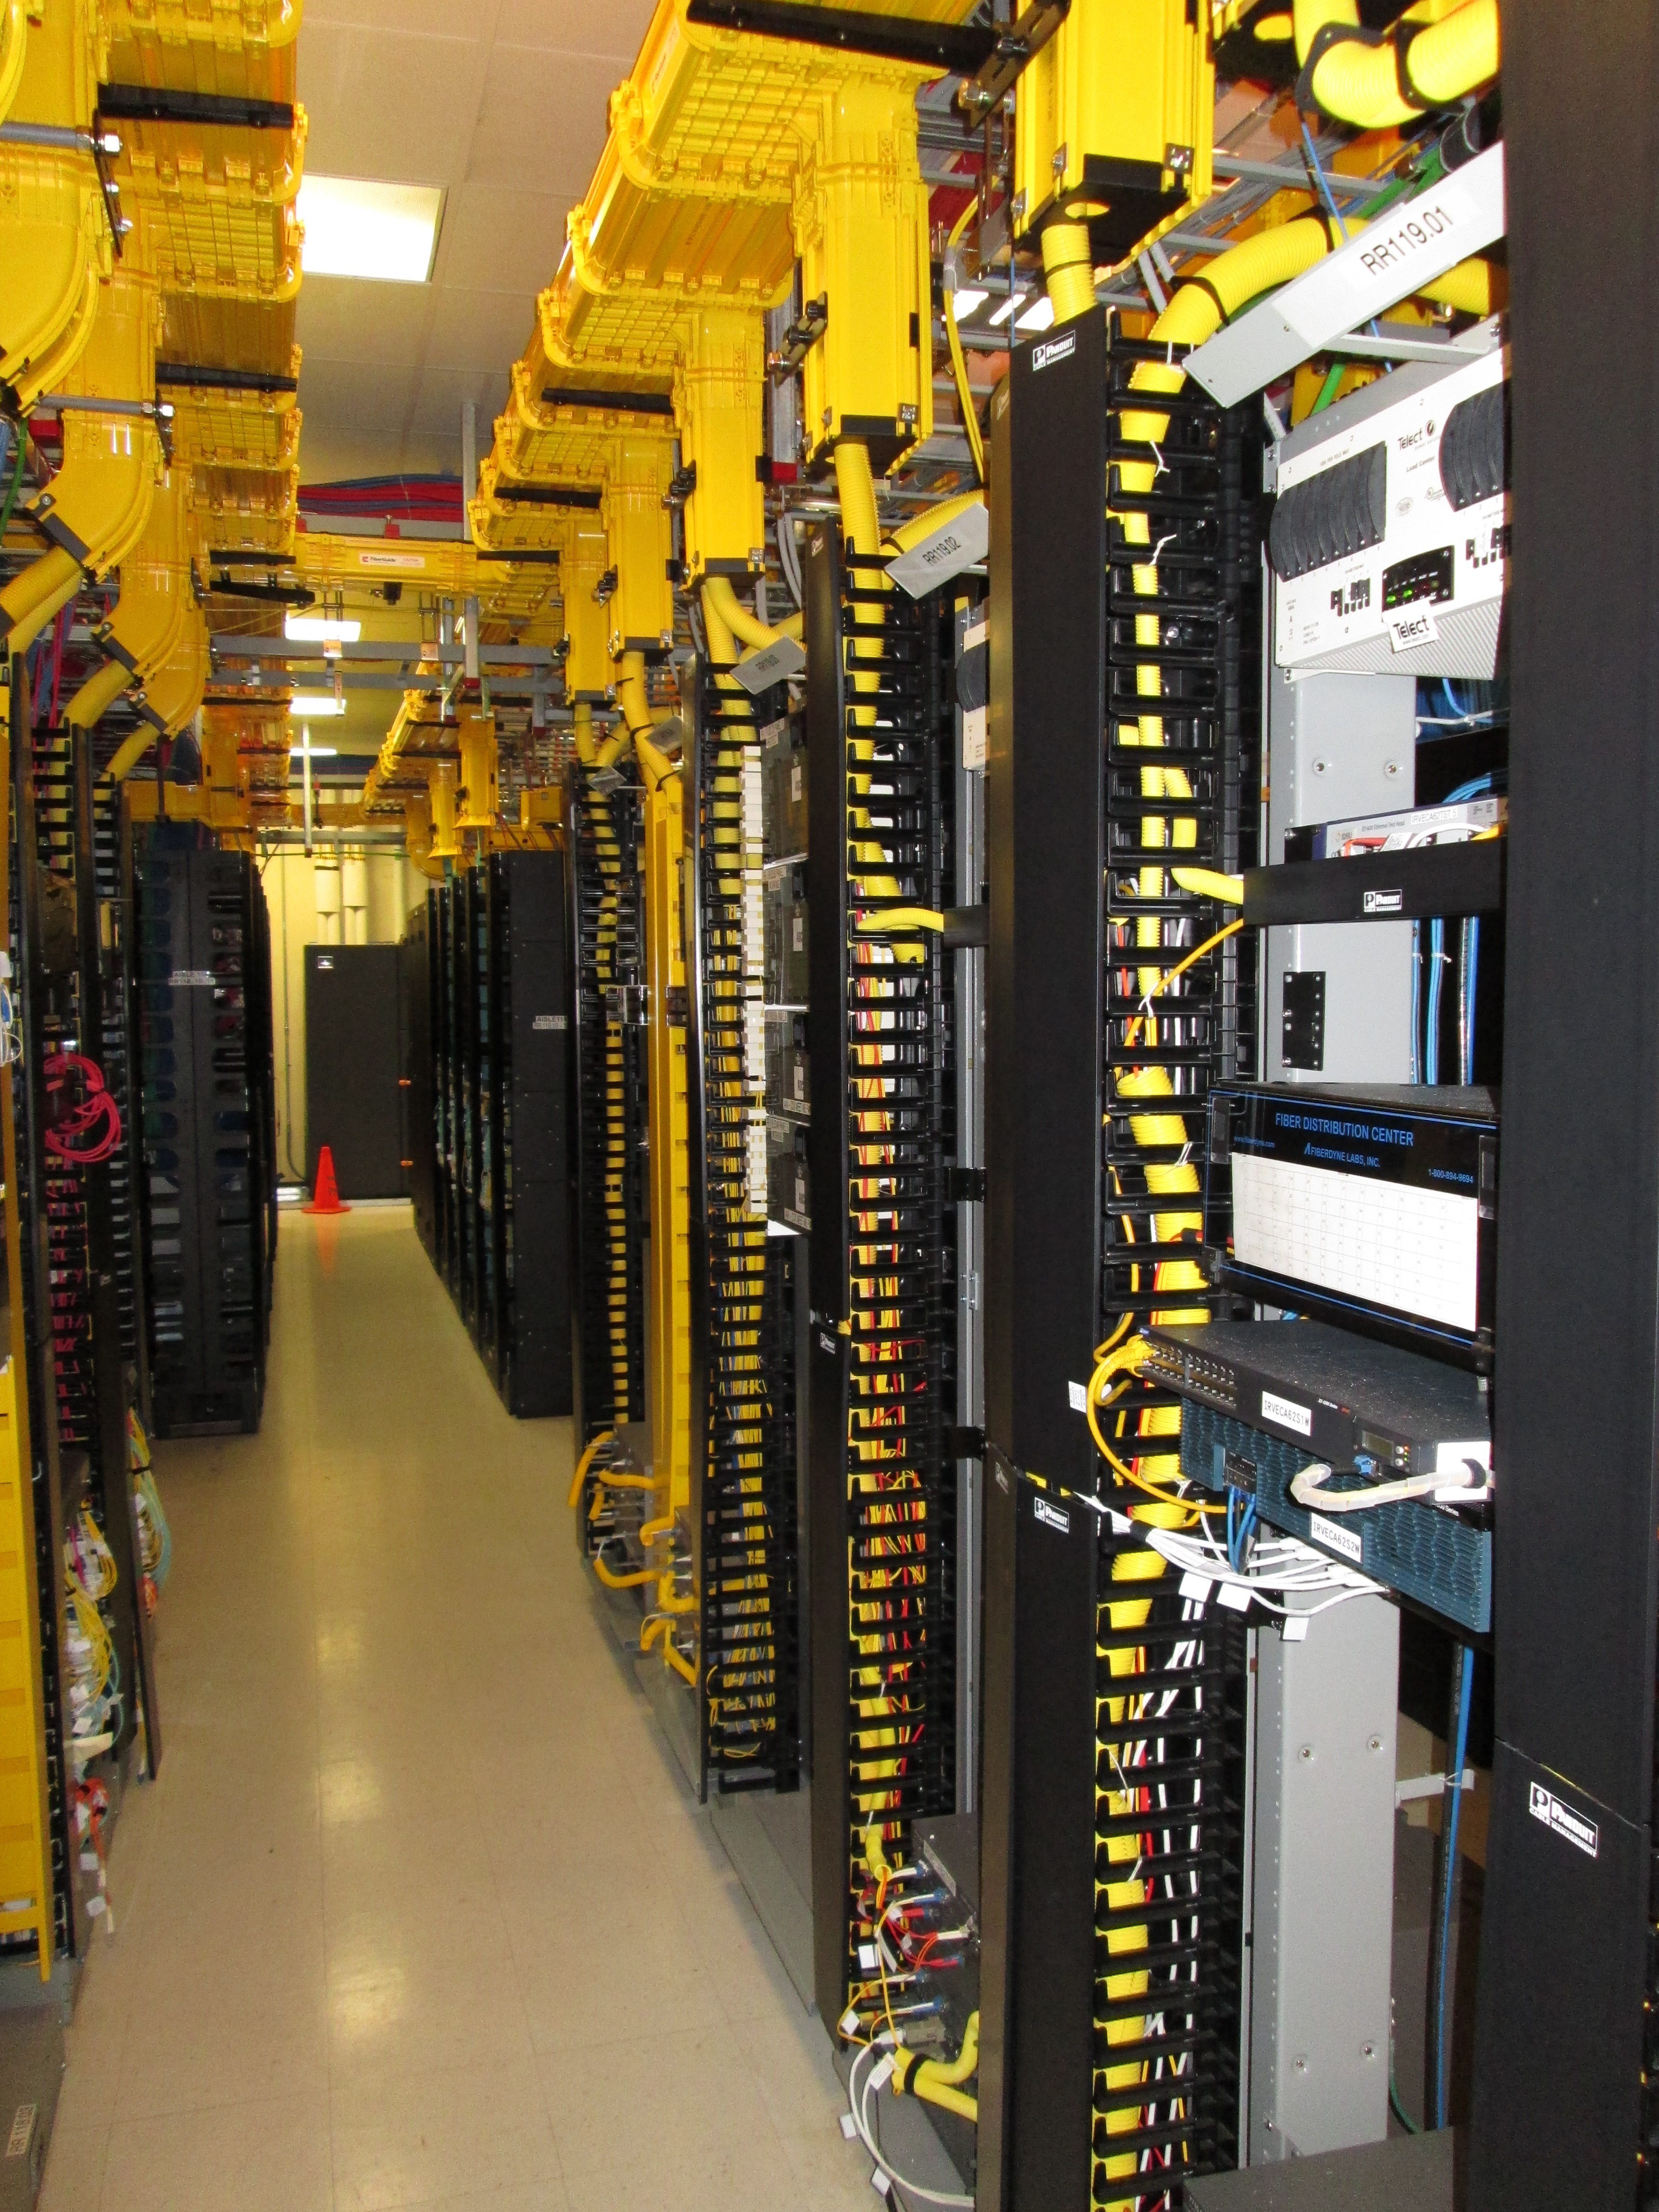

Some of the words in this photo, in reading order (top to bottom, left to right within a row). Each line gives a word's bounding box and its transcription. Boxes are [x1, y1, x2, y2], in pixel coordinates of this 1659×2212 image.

[1359, 204, 1453, 276] RR119.01
[1046, 337, 1073, 359] PANDUIT
[1397, 428, 1422, 451] Telect
[922, 536, 961, 566] RR119.02
[1392, 614, 1430, 640] Telect
[1412, 809, 1451, 823] IRVECA62TST
[1452, 809, 1457, 817] 5
[1375, 894, 1400, 905] PANDUIT
[1275, 1112, 1301, 1129] FIBER
[1303, 1116, 1369, 1140] DISTRIBUTION
[1371, 1126, 1414, 1146] CENTER
[1310, 1146, 1346, 1162] FIBERDYNE
[1346, 1153, 1366, 1166] LABS,
[1367, 1156, 1381, 1167] INC.
[1428, 1168, 1473, 1184] 1-800-894-9694
[1264, 1400, 1310, 1427] IRVECA62S1W
[1045, 1505, 1068, 1526] PANDUIT
[1445, 1505, 1459, 1516] Series
[1313, 1521, 1359, 1554] IRVECA62S2W
[1529, 1807, 1551, 1826] CABLE
[1551, 1821, 1598, 1858] MANAGEMENT
[1551, 1800, 1595, 1845] PANDUIT
